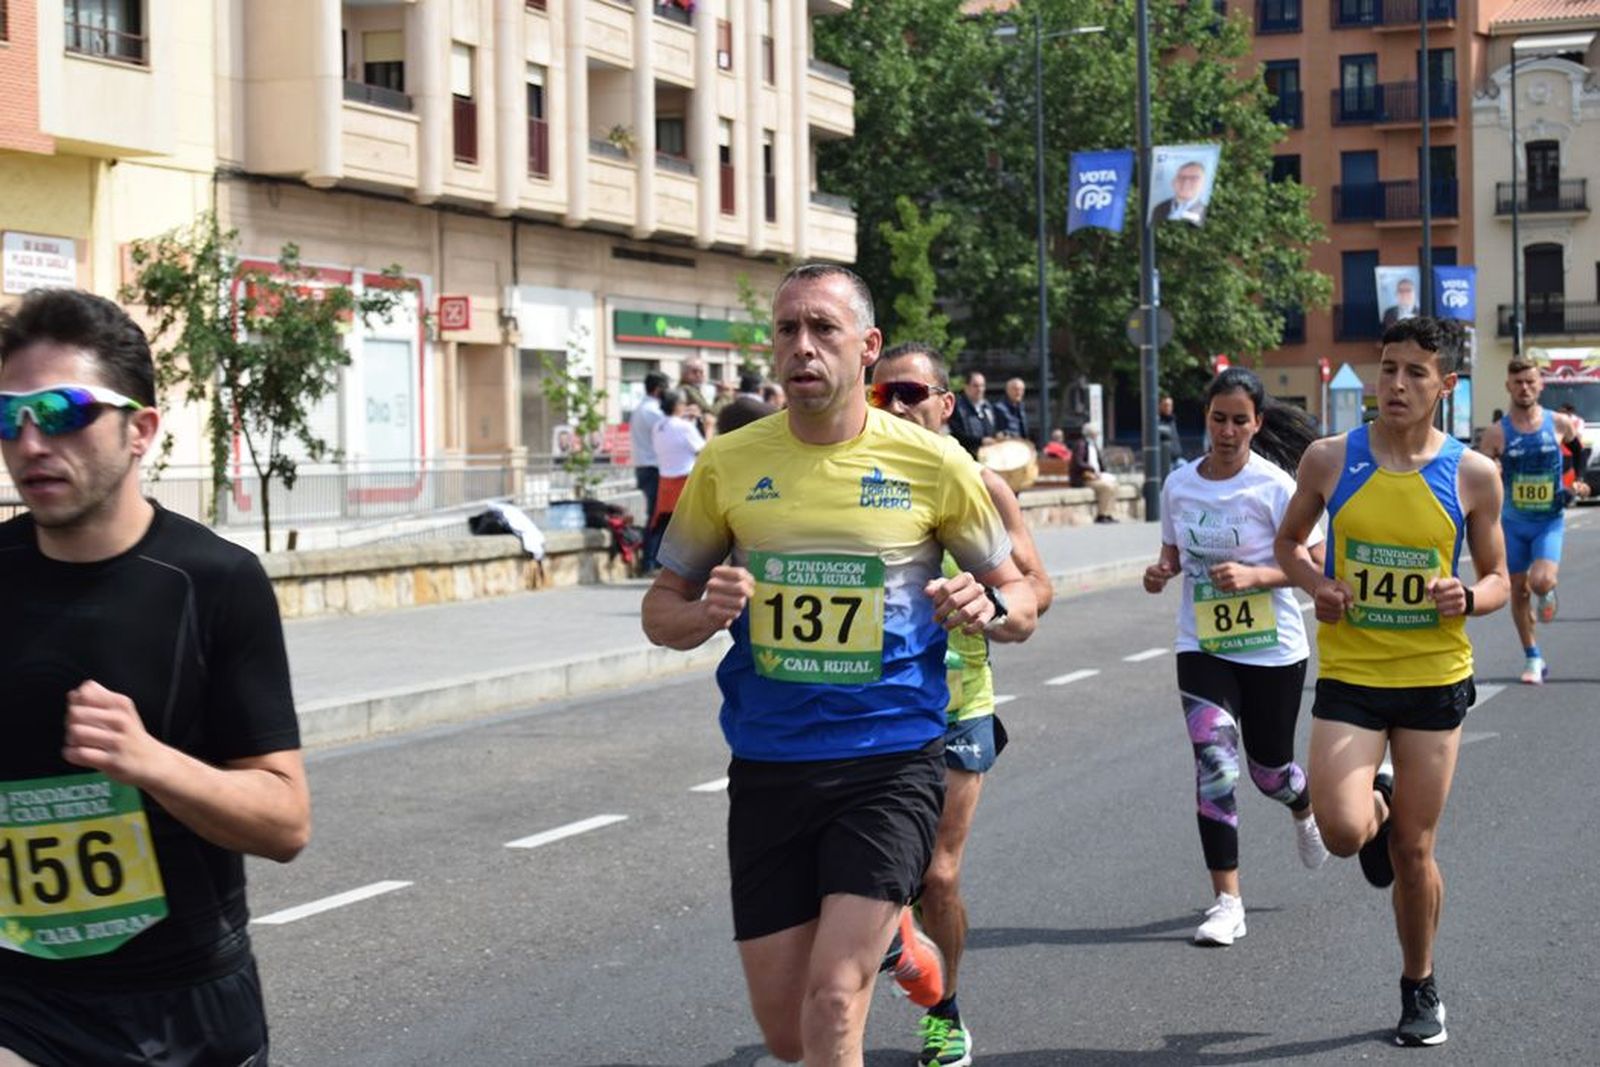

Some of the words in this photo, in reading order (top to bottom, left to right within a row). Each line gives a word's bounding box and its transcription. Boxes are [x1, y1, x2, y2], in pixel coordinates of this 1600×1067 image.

[1079, 169, 1117, 184] VOTA
[1441, 279, 1469, 289] VOTA
[1517, 484, 1548, 500] 180
[860, 496, 911, 509] DUERO
[1371, 547, 1429, 560] FUNDACION
[787, 560, 867, 574] FUNDACION
[787, 572, 820, 585] CAJA
[821, 573, 866, 586] RURAL
[1354, 568, 1425, 605] 140
[764, 592, 863, 644] 137
[1213, 600, 1255, 632] 84
[1368, 612, 1394, 623] CAJA
[1396, 614, 1433, 625] RURAL
[783, 657, 820, 672] CAJA
[823, 659, 874, 674] RURAL
[0, 831, 123, 904] 156
